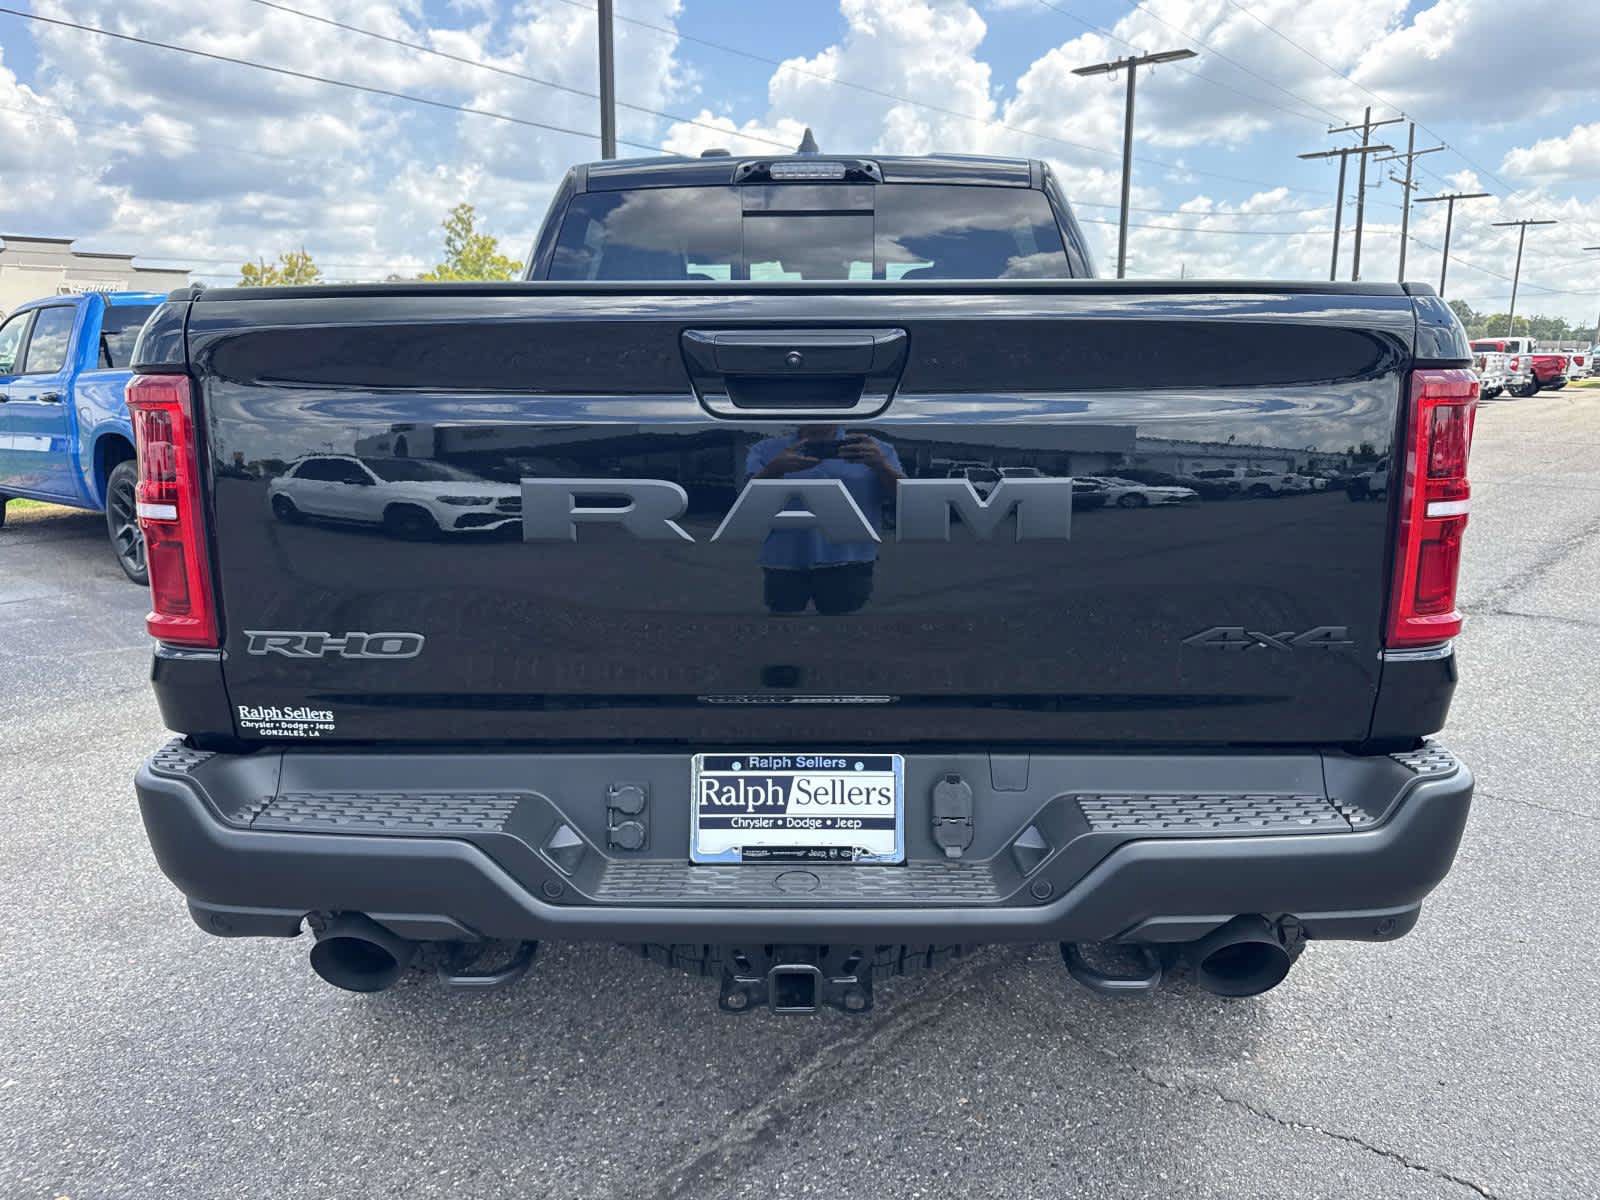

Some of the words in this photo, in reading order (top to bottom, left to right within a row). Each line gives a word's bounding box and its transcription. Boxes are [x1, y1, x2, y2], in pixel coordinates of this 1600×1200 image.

[520, 477, 1073, 543] RAM
[243, 630, 425, 659] RHO
[238, 705, 282, 721] Ralph
[283, 706, 334, 720] Sellers
[240, 721, 274, 729] Chrysler
[281, 721, 309, 730] Dodge
[315, 722, 335, 730] Jeep
[259, 729, 308, 737] GONZALES,
[748, 756, 792, 770] Ralph
[795, 756, 847, 769] Sellers
[699, 778, 785, 812] Ralph
[795, 778, 892, 806] Sellers
[731, 817, 774, 828] Chrysler
[786, 817, 822, 829] Dodge
[834, 817, 862, 829] Jeep
